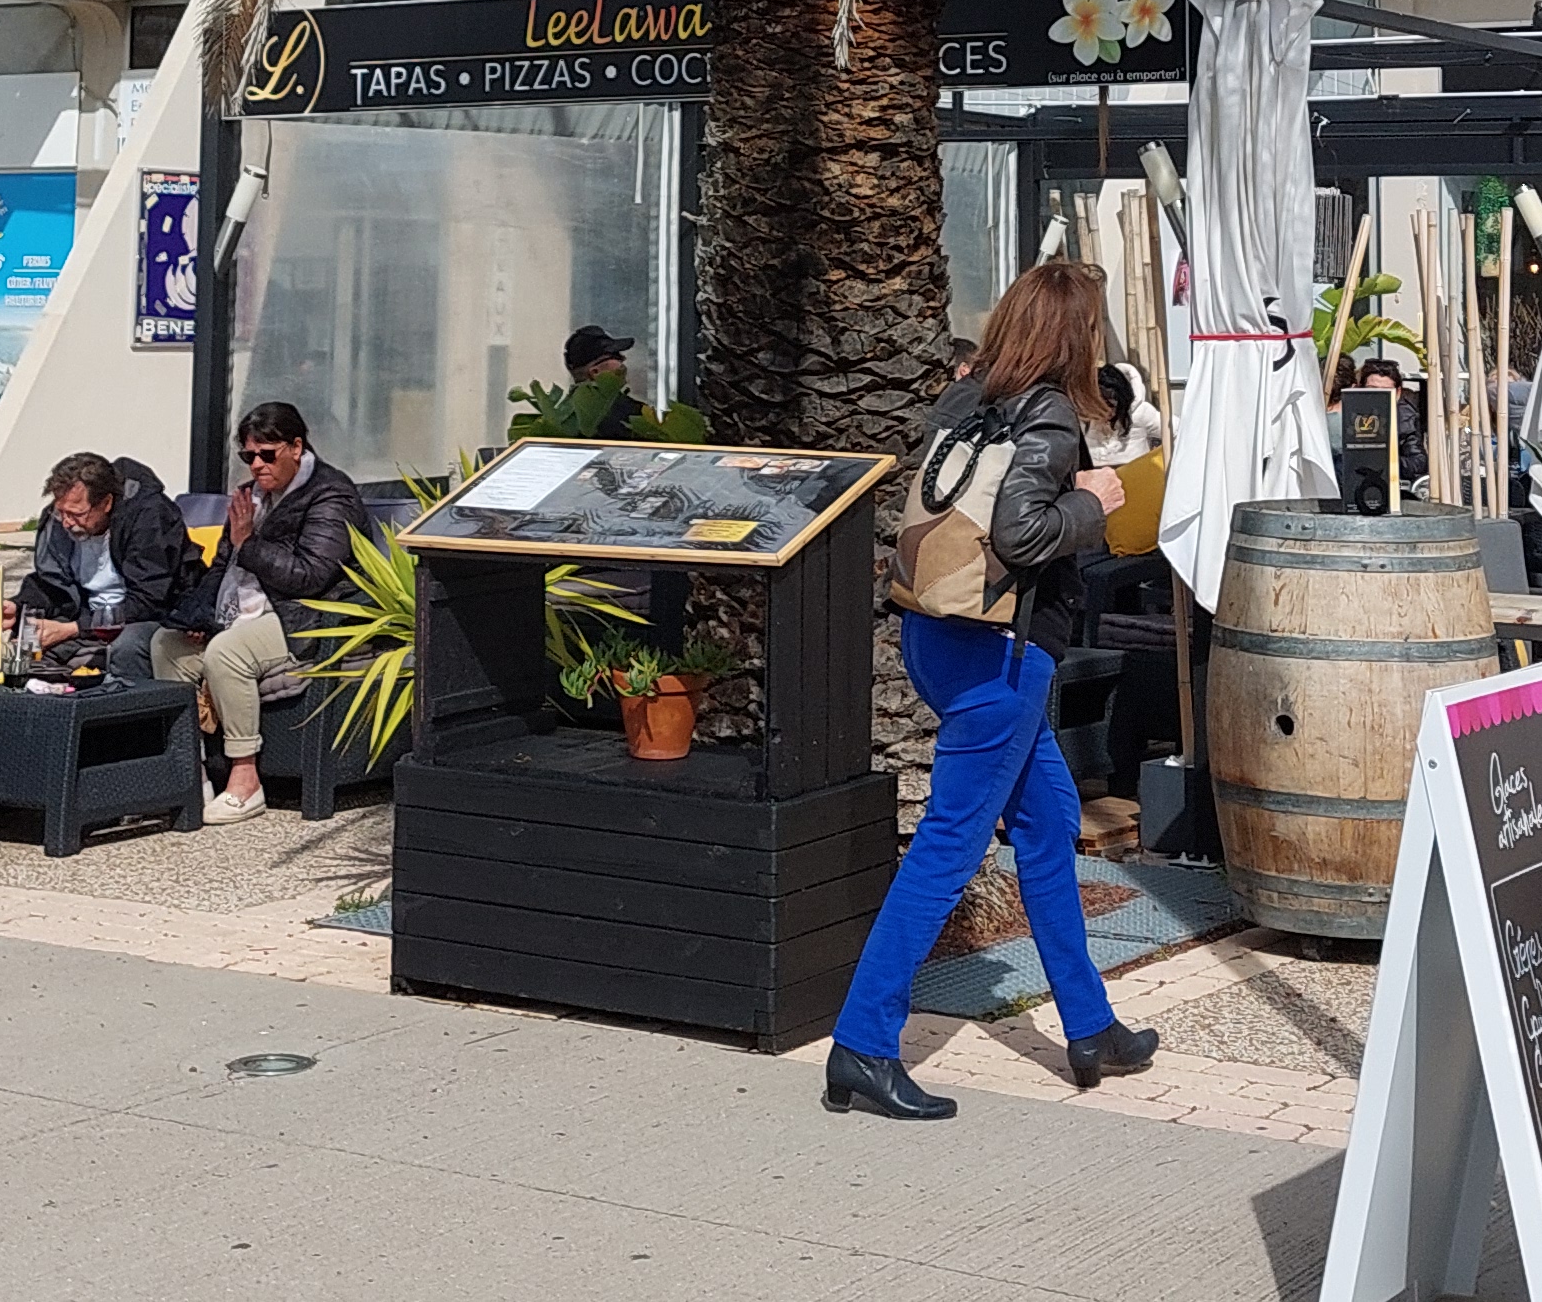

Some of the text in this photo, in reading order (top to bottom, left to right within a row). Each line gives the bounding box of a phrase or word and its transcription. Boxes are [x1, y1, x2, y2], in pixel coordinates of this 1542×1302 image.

[349, 64, 447, 105] TAPAS
[484, 56, 593, 92] PIZZAS
[1070, 71, 1098, 84] place
[1100, 72, 1115, 81] ou
[142, 318, 196, 335] BENE
